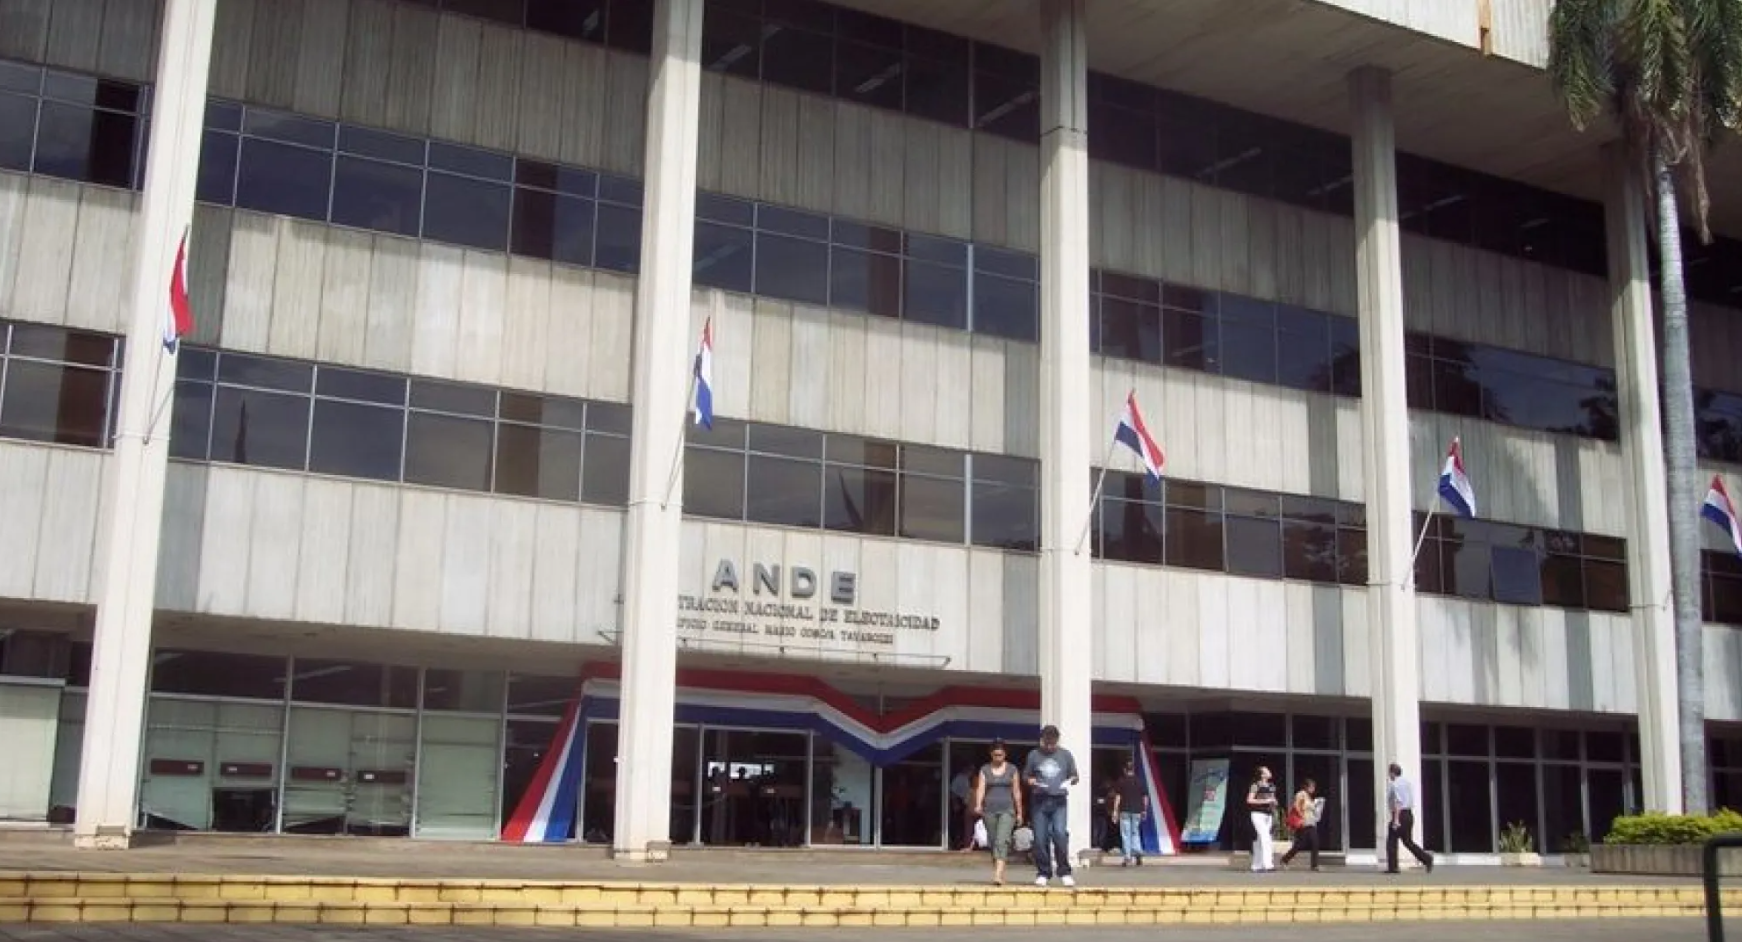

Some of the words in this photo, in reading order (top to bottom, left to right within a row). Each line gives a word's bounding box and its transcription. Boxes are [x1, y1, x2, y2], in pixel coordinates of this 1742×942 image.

[712, 559, 855, 606] ANDE
[744, 601, 813, 620] NACIONAL
[820, 607, 838, 623] DE
[845, 609, 940, 631] ELECTRICIDAD
